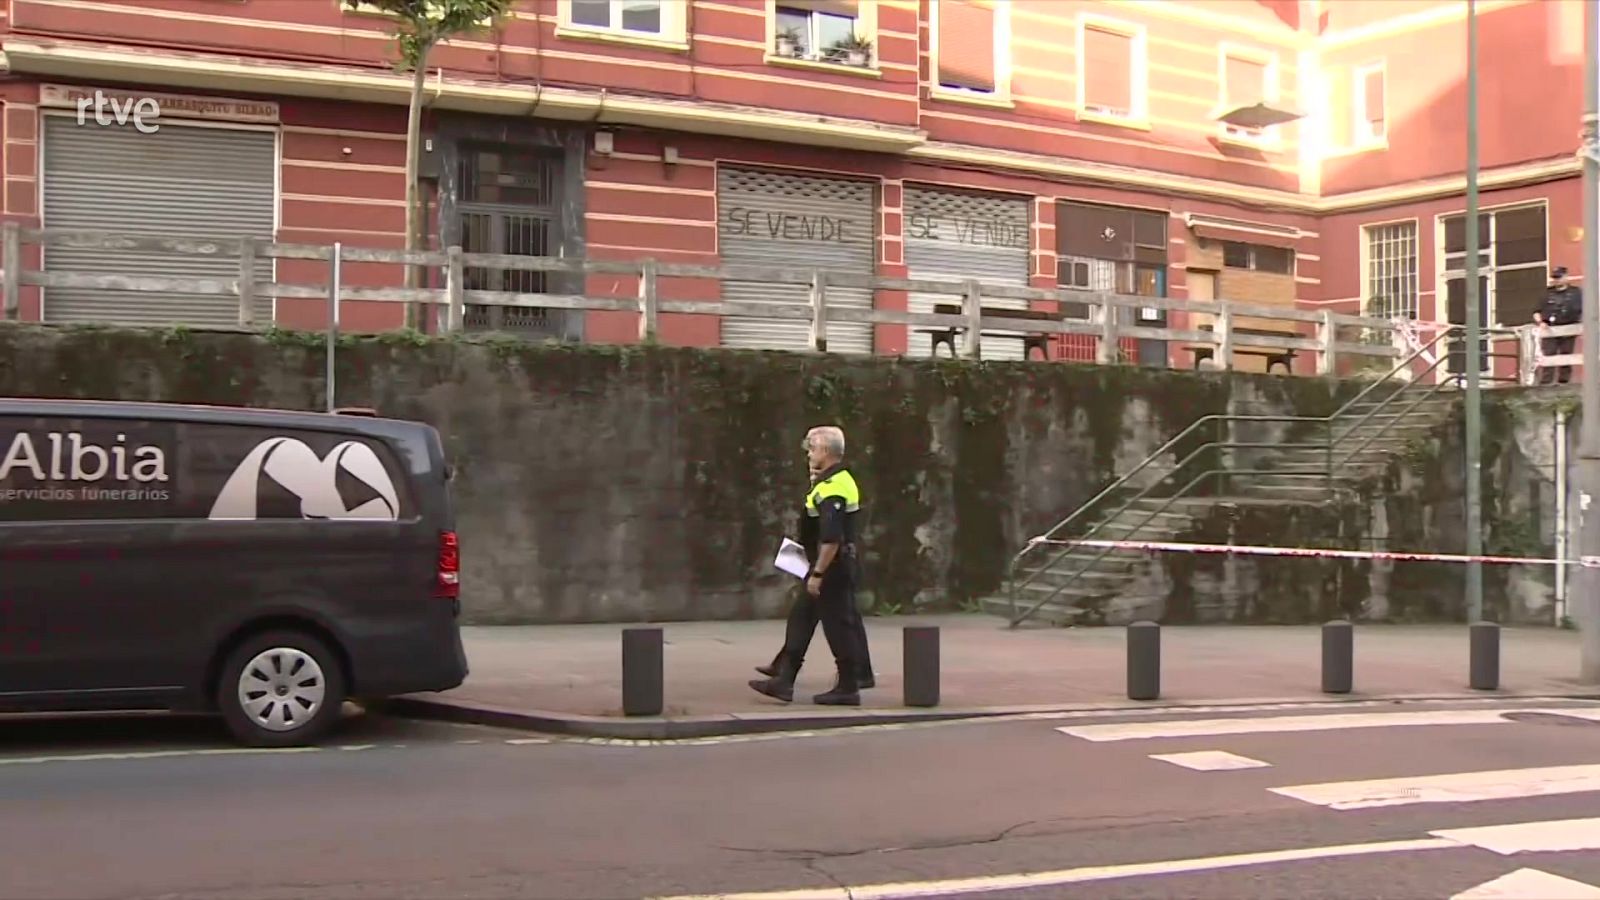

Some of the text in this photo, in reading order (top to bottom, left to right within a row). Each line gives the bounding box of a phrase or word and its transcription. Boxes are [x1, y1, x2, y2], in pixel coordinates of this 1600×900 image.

[728, 207, 857, 243] SE VENDE
[909, 213, 1027, 249] SE VENDE
[0, 432, 169, 482] Albia
[0, 486, 169, 501] servicios funerarios
